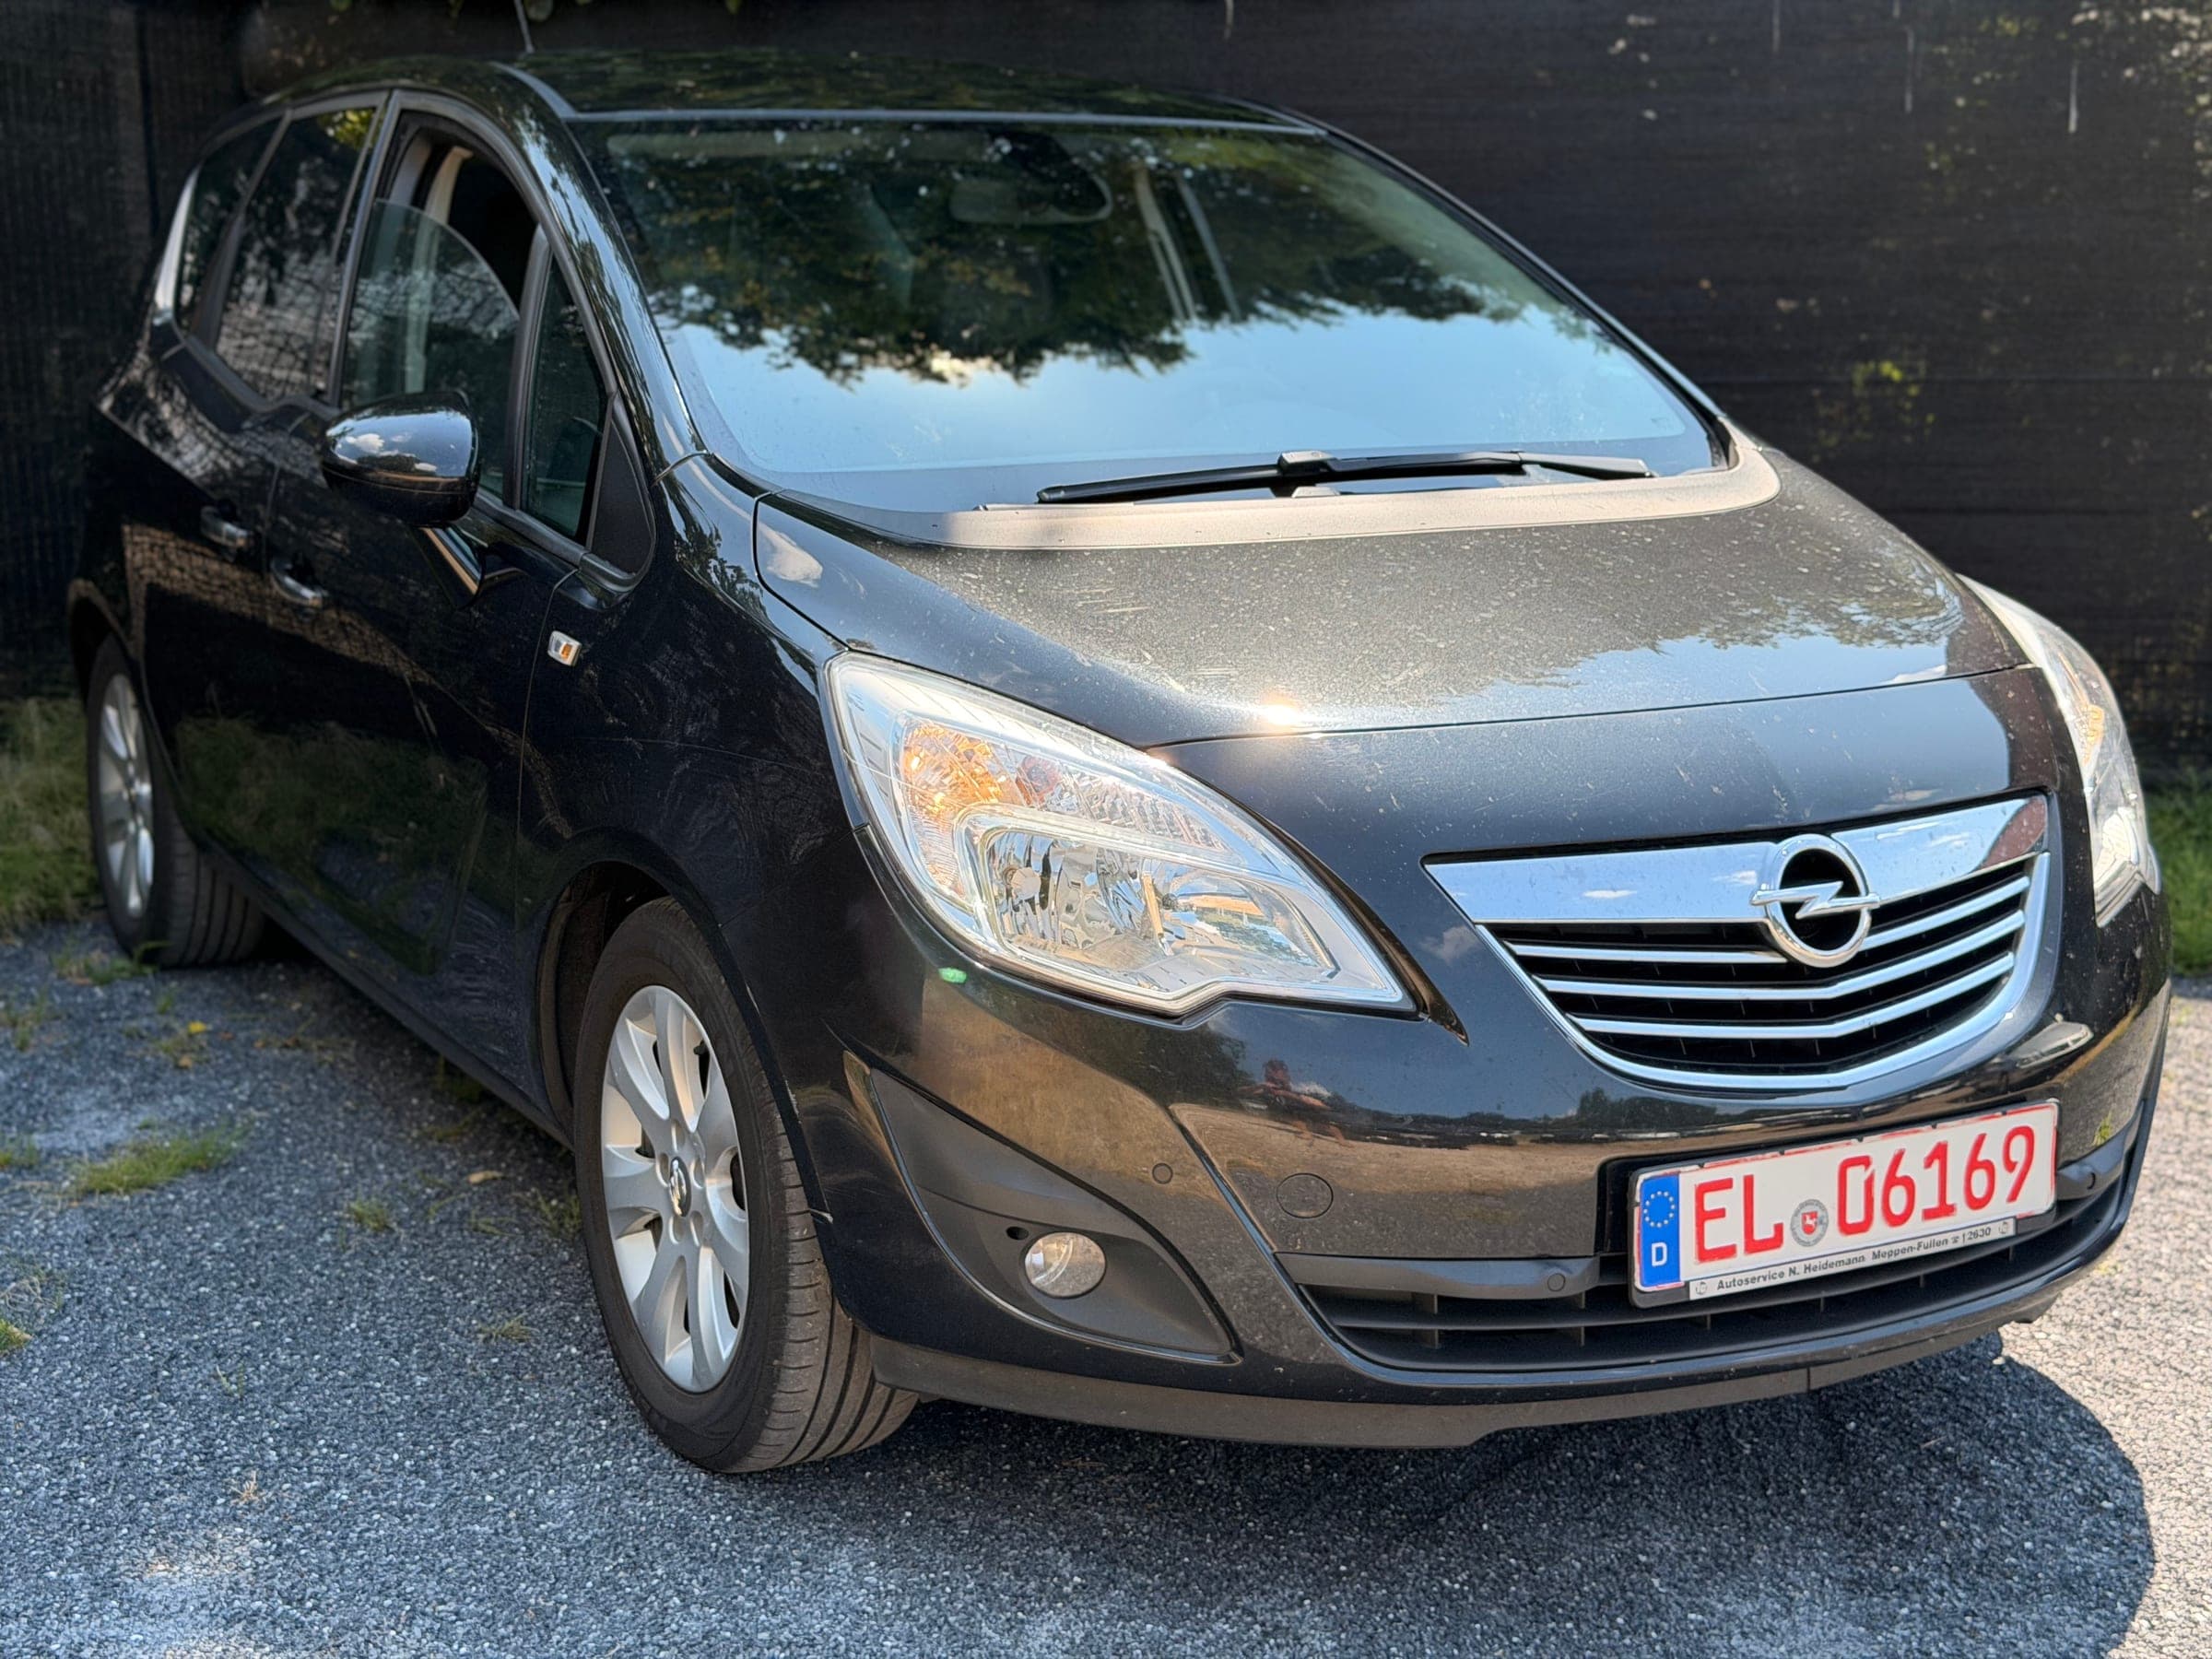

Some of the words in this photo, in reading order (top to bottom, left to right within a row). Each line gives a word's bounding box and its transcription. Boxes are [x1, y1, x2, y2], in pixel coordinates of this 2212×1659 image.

[1694, 1175, 1784, 1264] EL
[1837, 1125, 2035, 1237] 06169
[1651, 1241, 1667, 1266] D
[1716, 1271, 1785, 1290] Autoservice
[1788, 1266, 1800, 1277] N.
[1804, 1254, 1866, 1274] Heidemann
[1871, 1238, 1948, 1261] Meppen-Fullen
